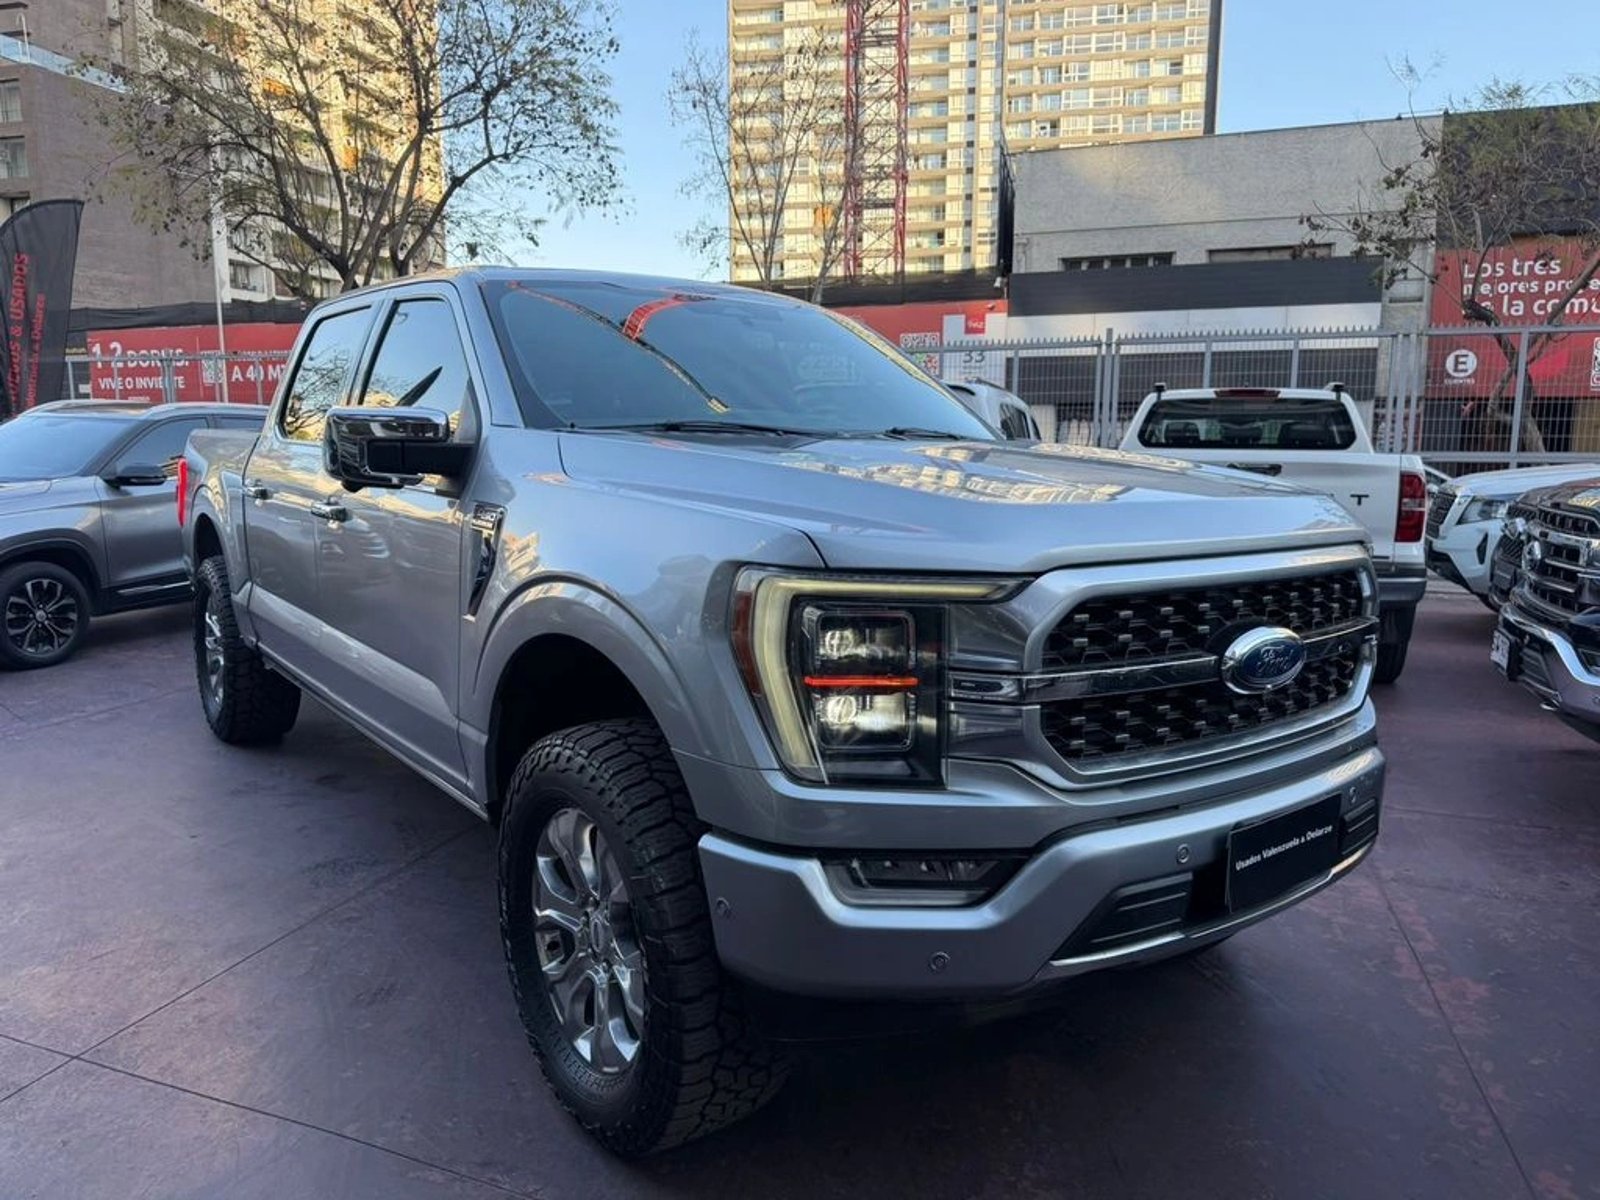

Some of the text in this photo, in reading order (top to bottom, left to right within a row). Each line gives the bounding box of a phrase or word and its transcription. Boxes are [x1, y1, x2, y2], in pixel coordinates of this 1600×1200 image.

[1464, 258, 1561, 278] Los tres
[10, 252, 29, 320] USADOS
[1502, 295, 1524, 316] la
[92, 343, 103, 369] 1
[109, 341, 124, 368] 2
[1453, 354, 1469, 373] E
[98, 376, 185, 390] VIVE O INVIETE
[231, 365, 244, 382] A
[1235, 854, 1262, 871] Usados
[1262, 837, 1300, 859] Valenzuela
